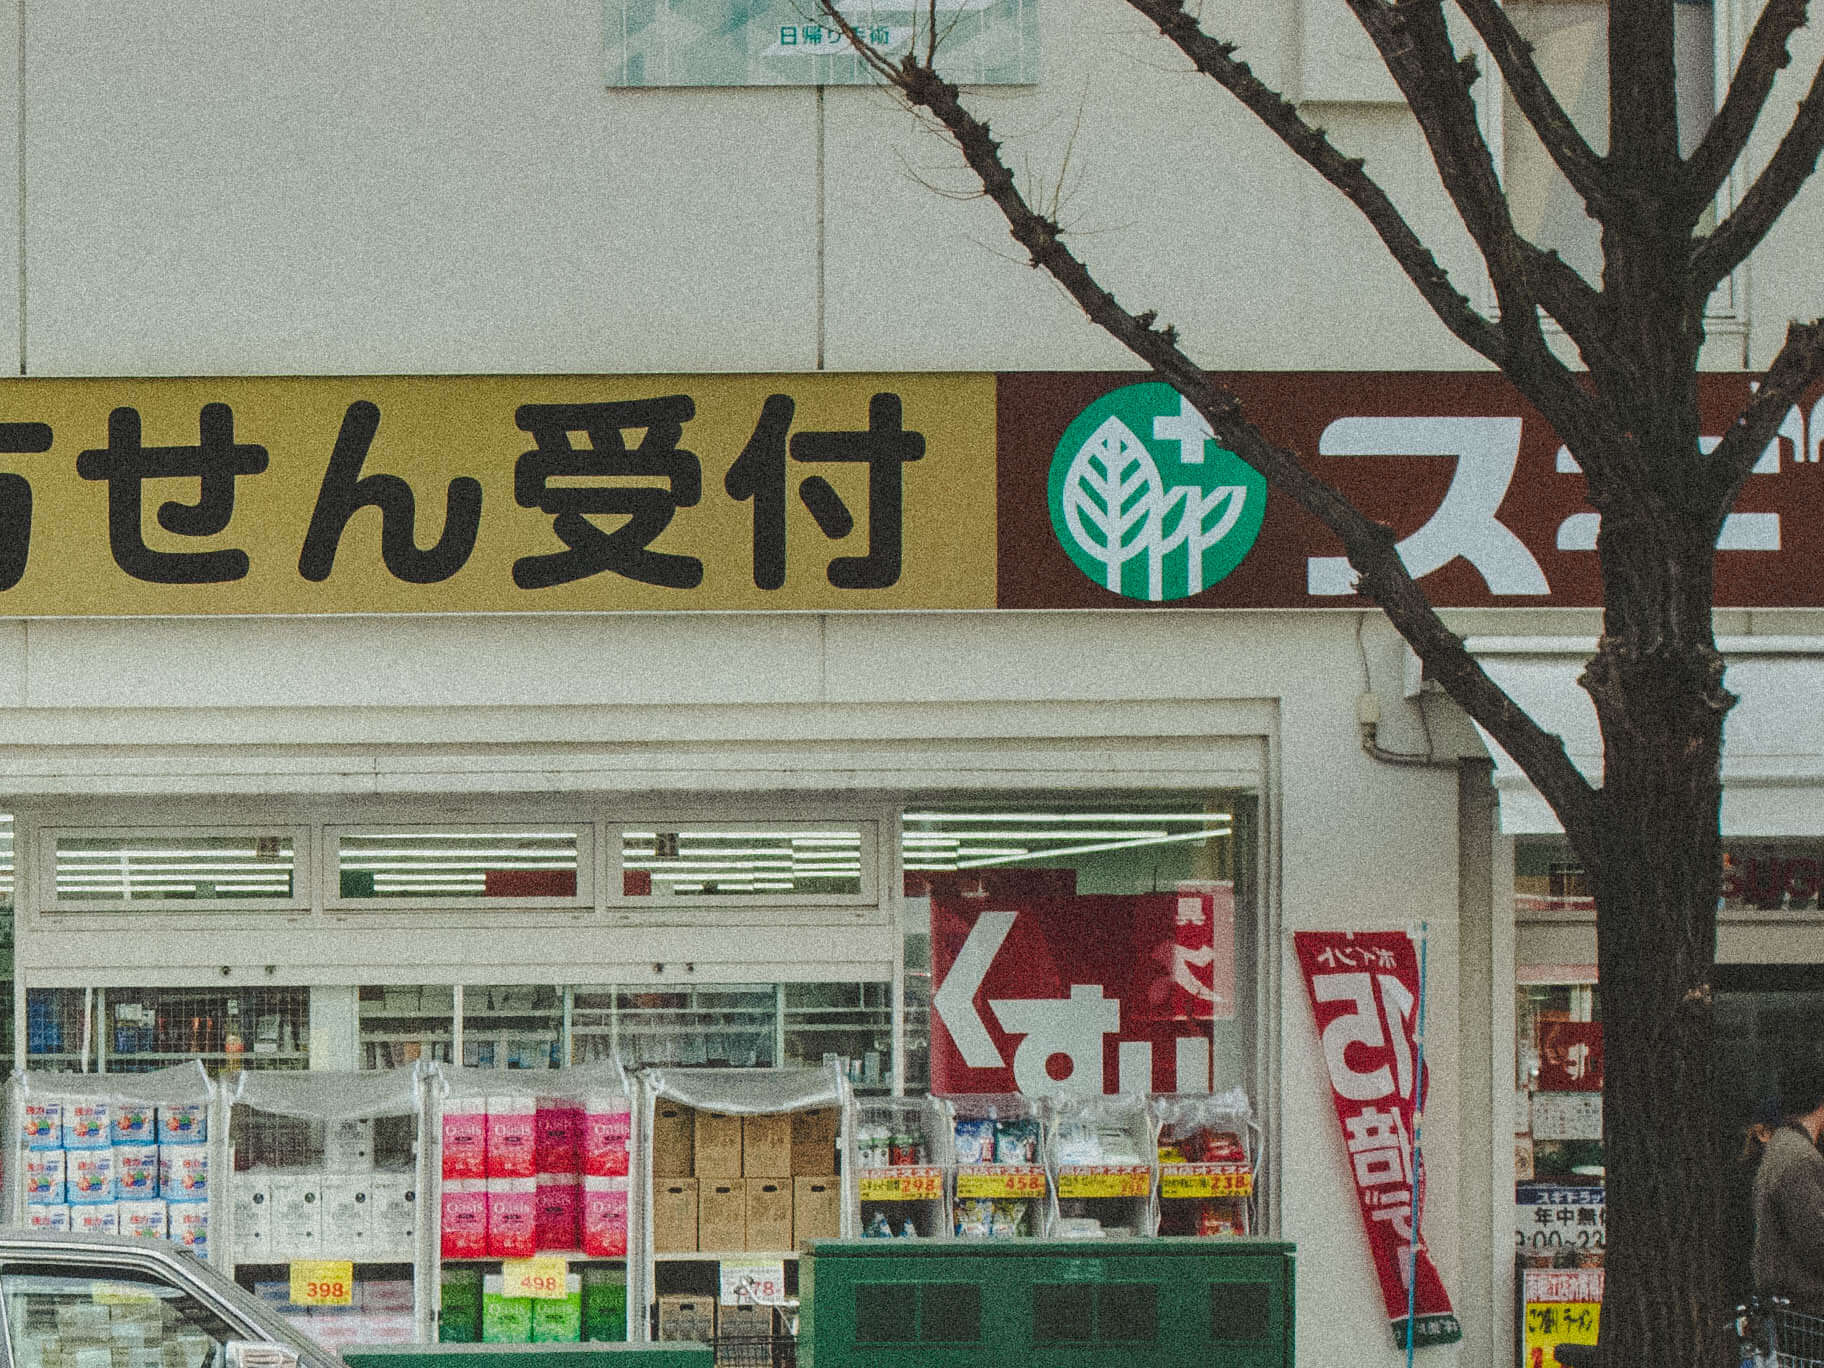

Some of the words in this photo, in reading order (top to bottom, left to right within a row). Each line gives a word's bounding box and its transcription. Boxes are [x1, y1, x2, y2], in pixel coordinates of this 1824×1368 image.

[1005, 1176, 1040, 1190] 458
[1211, 1176, 1245, 1190] 238
[307, 1283, 344, 1298] 398
[521, 1277, 556, 1291] 498
